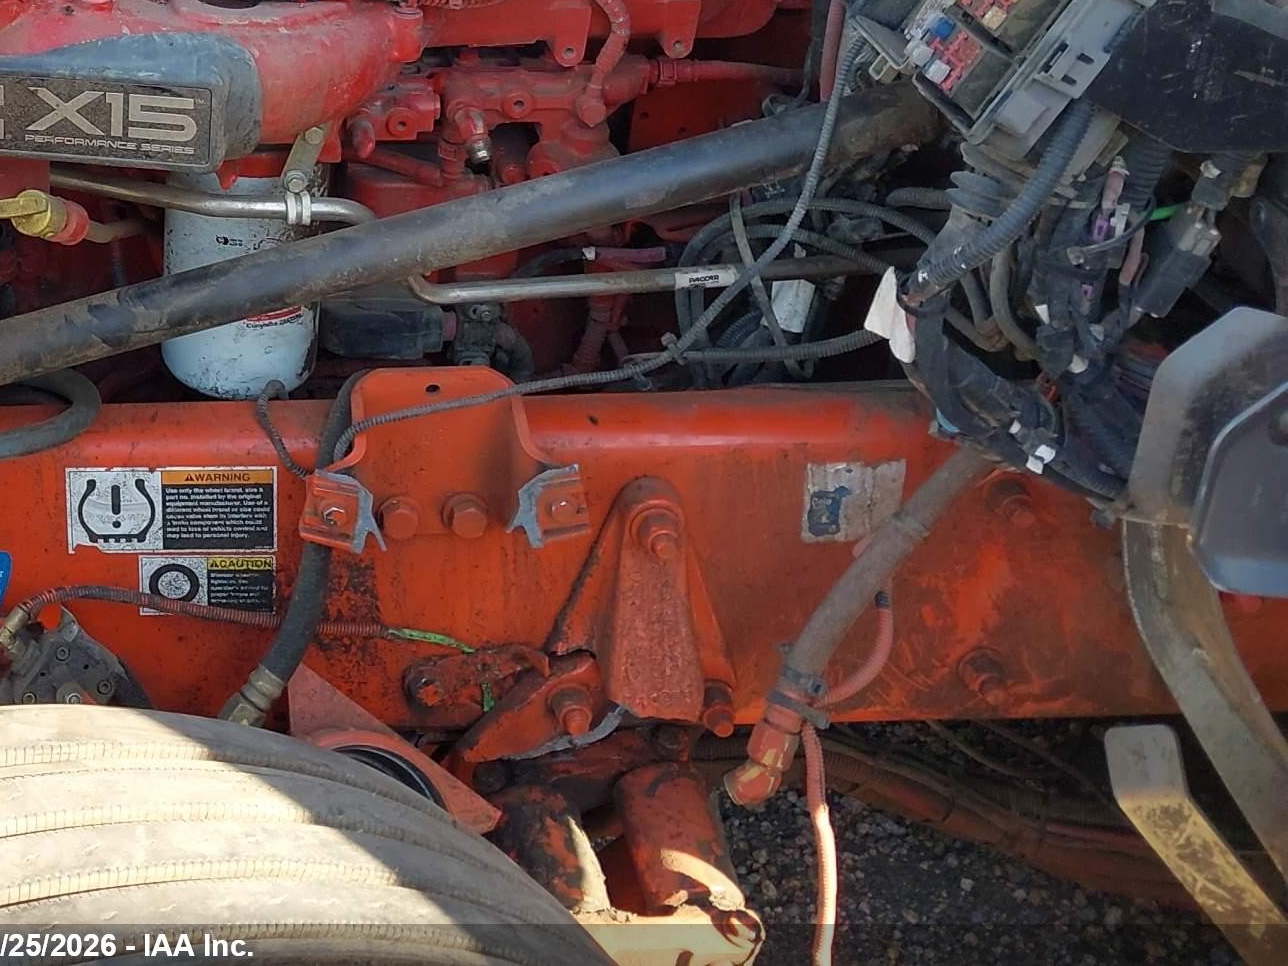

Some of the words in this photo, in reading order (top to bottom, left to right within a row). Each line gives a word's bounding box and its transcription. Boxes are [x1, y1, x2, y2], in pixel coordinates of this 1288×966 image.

[25, 86, 198, 142] X15
[24, 134, 138, 152] PERFORMANCE
[140, 143, 196, 155] SERIES
[193, 472, 251, 482] WARNING
[220, 559, 271, 568] CAUTION
